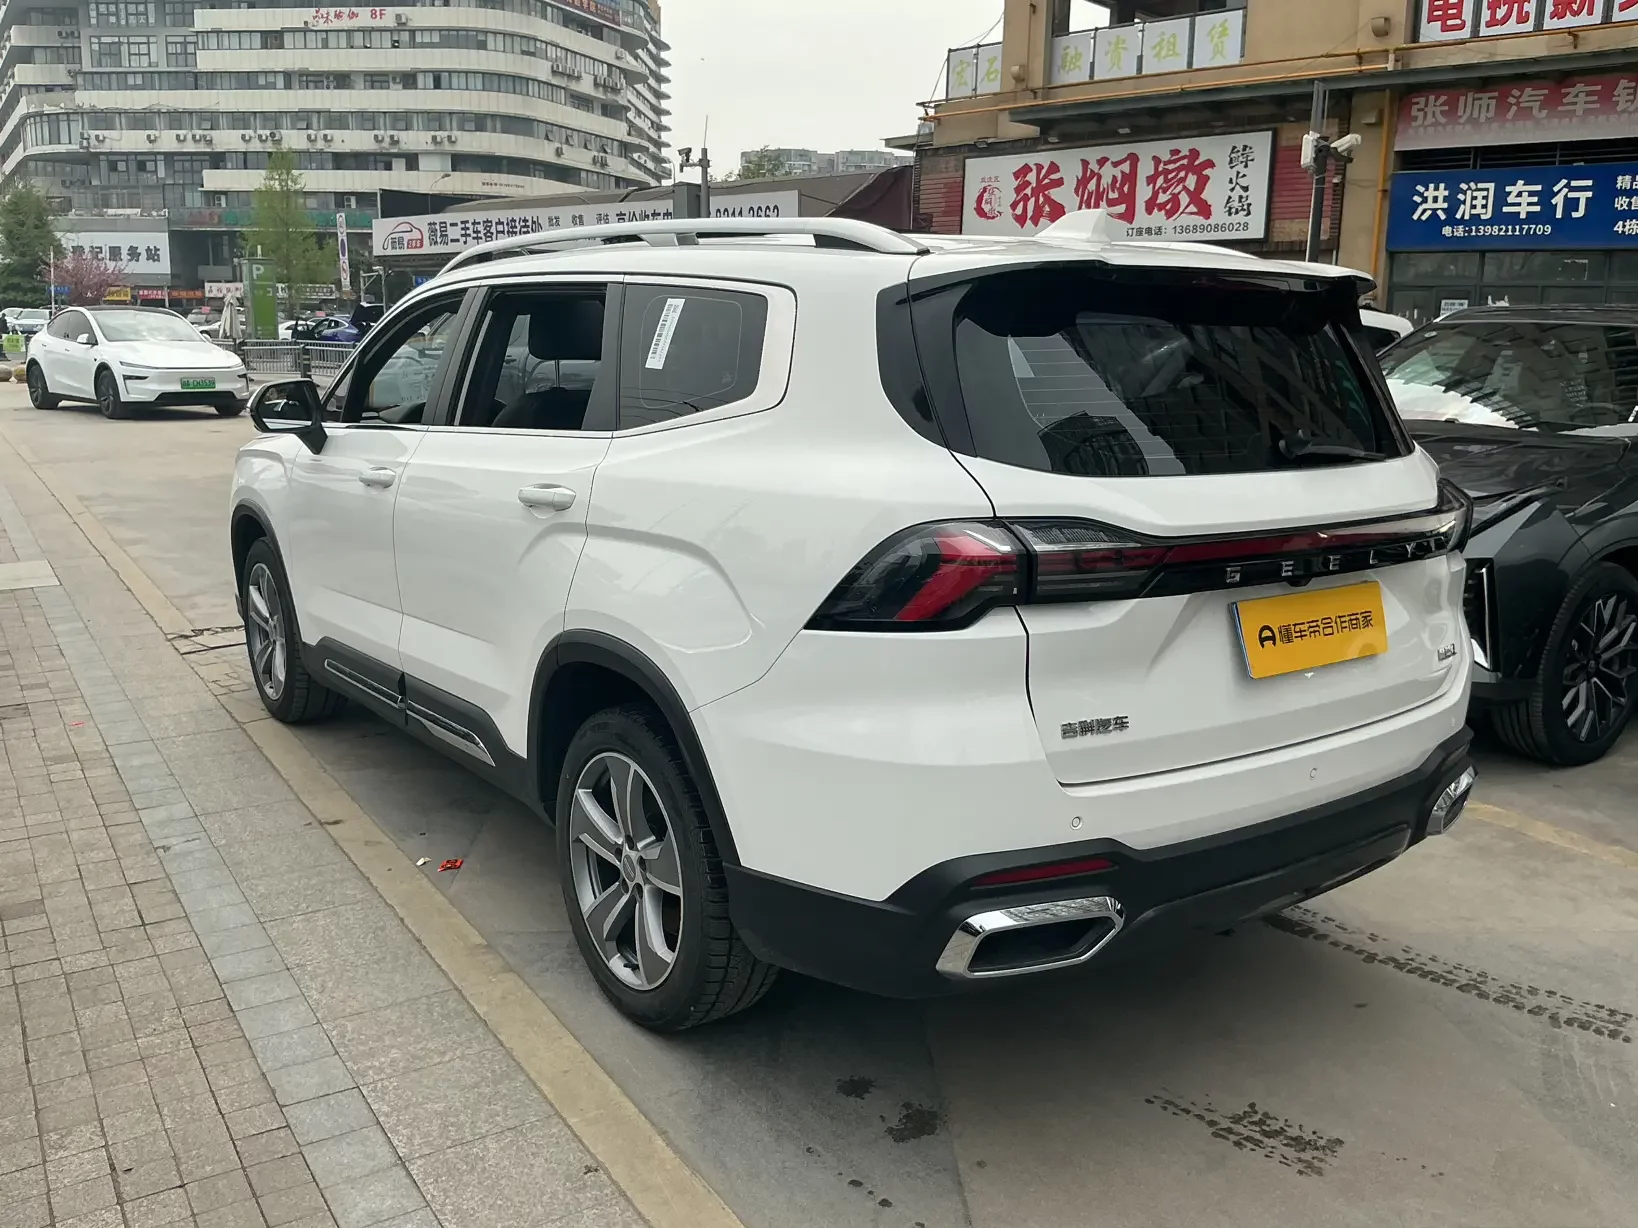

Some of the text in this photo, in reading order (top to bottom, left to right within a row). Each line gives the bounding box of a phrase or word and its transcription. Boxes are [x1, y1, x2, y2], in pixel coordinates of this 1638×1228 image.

[370, 8, 386, 20] 8F
[1009, 147, 1217, 229] 张焖墩
[1224, 144, 1255, 218] 鲜火锅
[1412, 178, 1594, 222] 洪润车行
[252, 264, 264, 280] P
[1225, 541, 1417, 584] GEELY
[1278, 610, 1374, 644] 懂车帝合作商家
